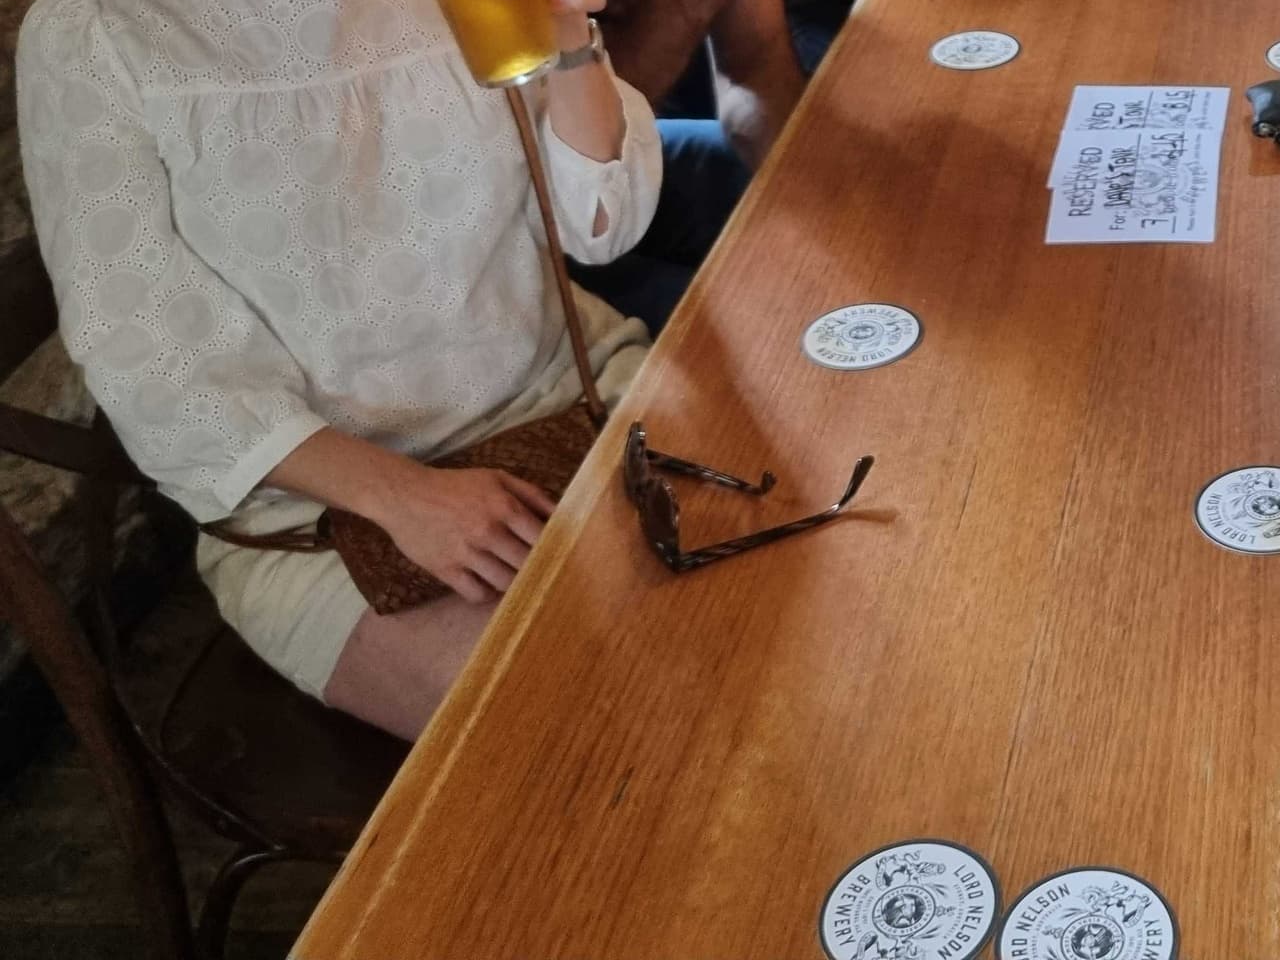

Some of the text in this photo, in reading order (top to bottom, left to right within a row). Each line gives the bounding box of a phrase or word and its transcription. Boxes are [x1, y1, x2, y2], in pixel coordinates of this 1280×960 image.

[1068, 146, 1103, 217] RESERVED
[1206, 493, 1257, 544] LORD NELSON
[834, 873, 871, 947] BREWERY
[936, 863, 985, 960] LORD NELSON
[1016, 883, 1071, 931] NELSON
